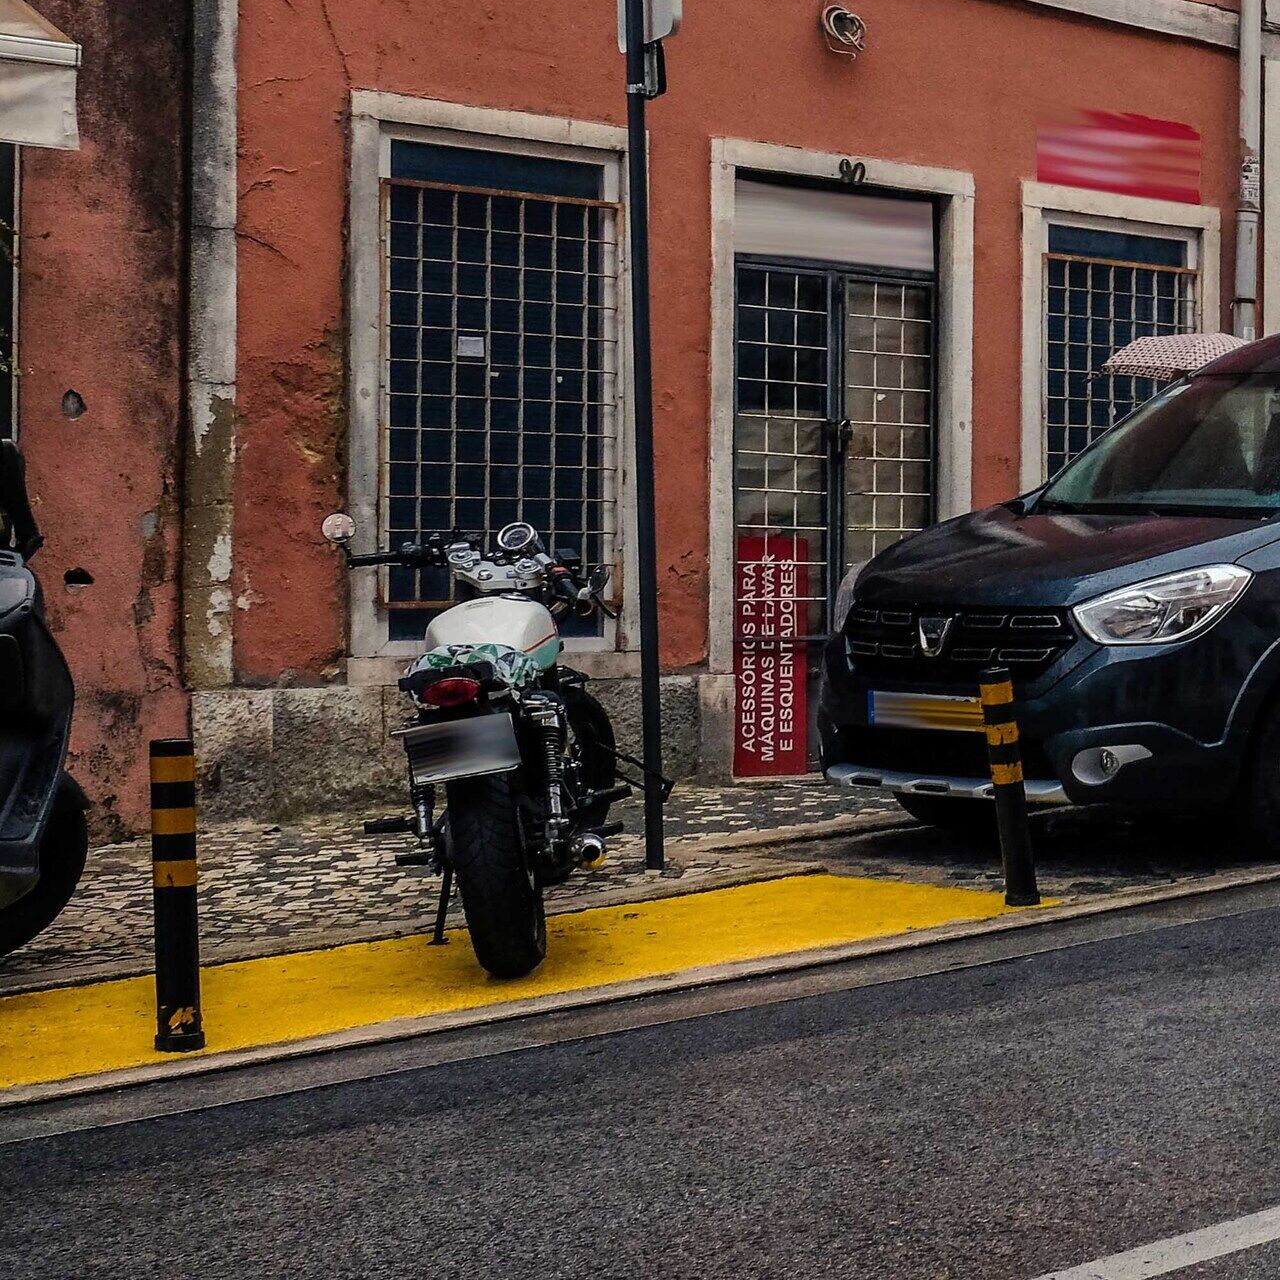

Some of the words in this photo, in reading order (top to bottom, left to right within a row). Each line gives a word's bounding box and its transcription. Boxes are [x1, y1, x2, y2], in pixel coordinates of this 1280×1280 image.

[742, 562, 757, 616] PARA
[760, 553, 776, 617] LAVAR
[761, 623, 775, 650] DE
[779, 558, 795, 733] ESQUENTADORES
[739, 622, 757, 753] ACESSÓRIOS
[757, 656, 775, 762] MÁQUINAS
[780, 738, 793, 752] E
